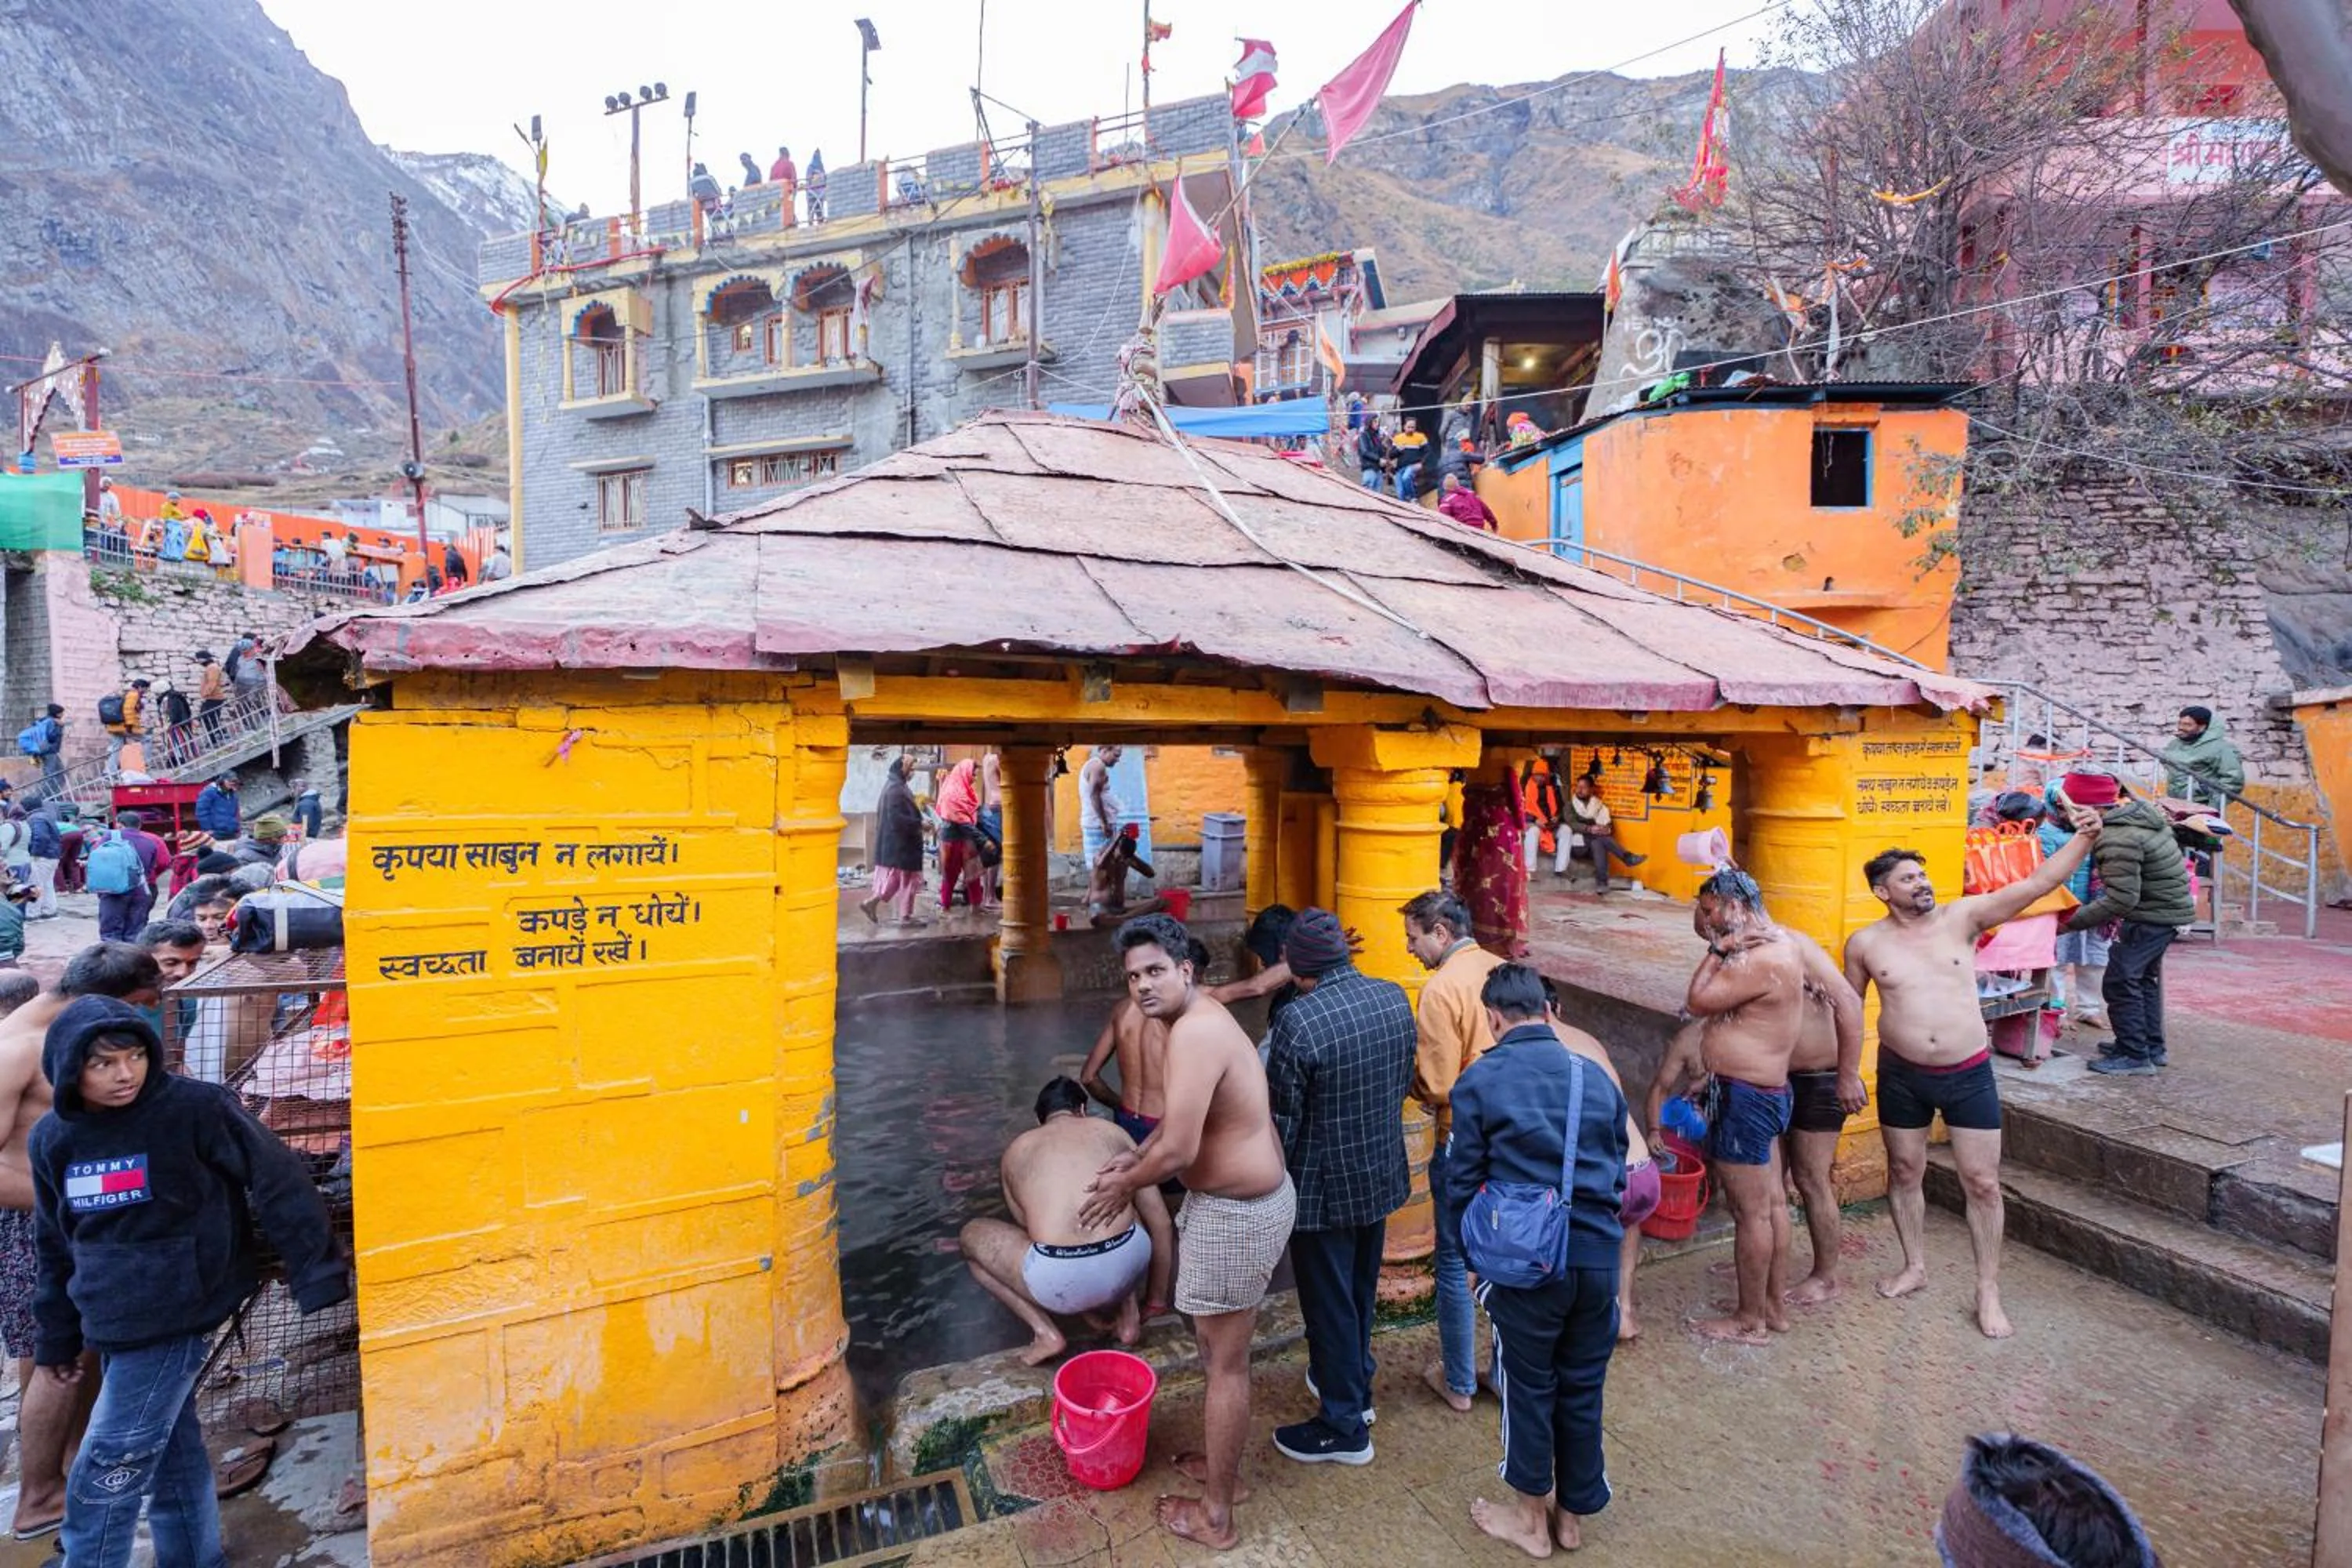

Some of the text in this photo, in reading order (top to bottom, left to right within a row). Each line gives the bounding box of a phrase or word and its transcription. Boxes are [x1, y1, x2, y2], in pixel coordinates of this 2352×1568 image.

[372, 843, 459, 880] कृपया
[463, 841, 540, 873] साबुन
[554, 843, 580, 868] न
[517, 895, 590, 935] कपड़े
[596, 906, 622, 928] न
[379, 949, 488, 981] स्वच्छता
[512, 935, 586, 968] बनायें
[72, 1159, 135, 1176] TOMMY
[73, 1189, 143, 1207] HILFIGER
